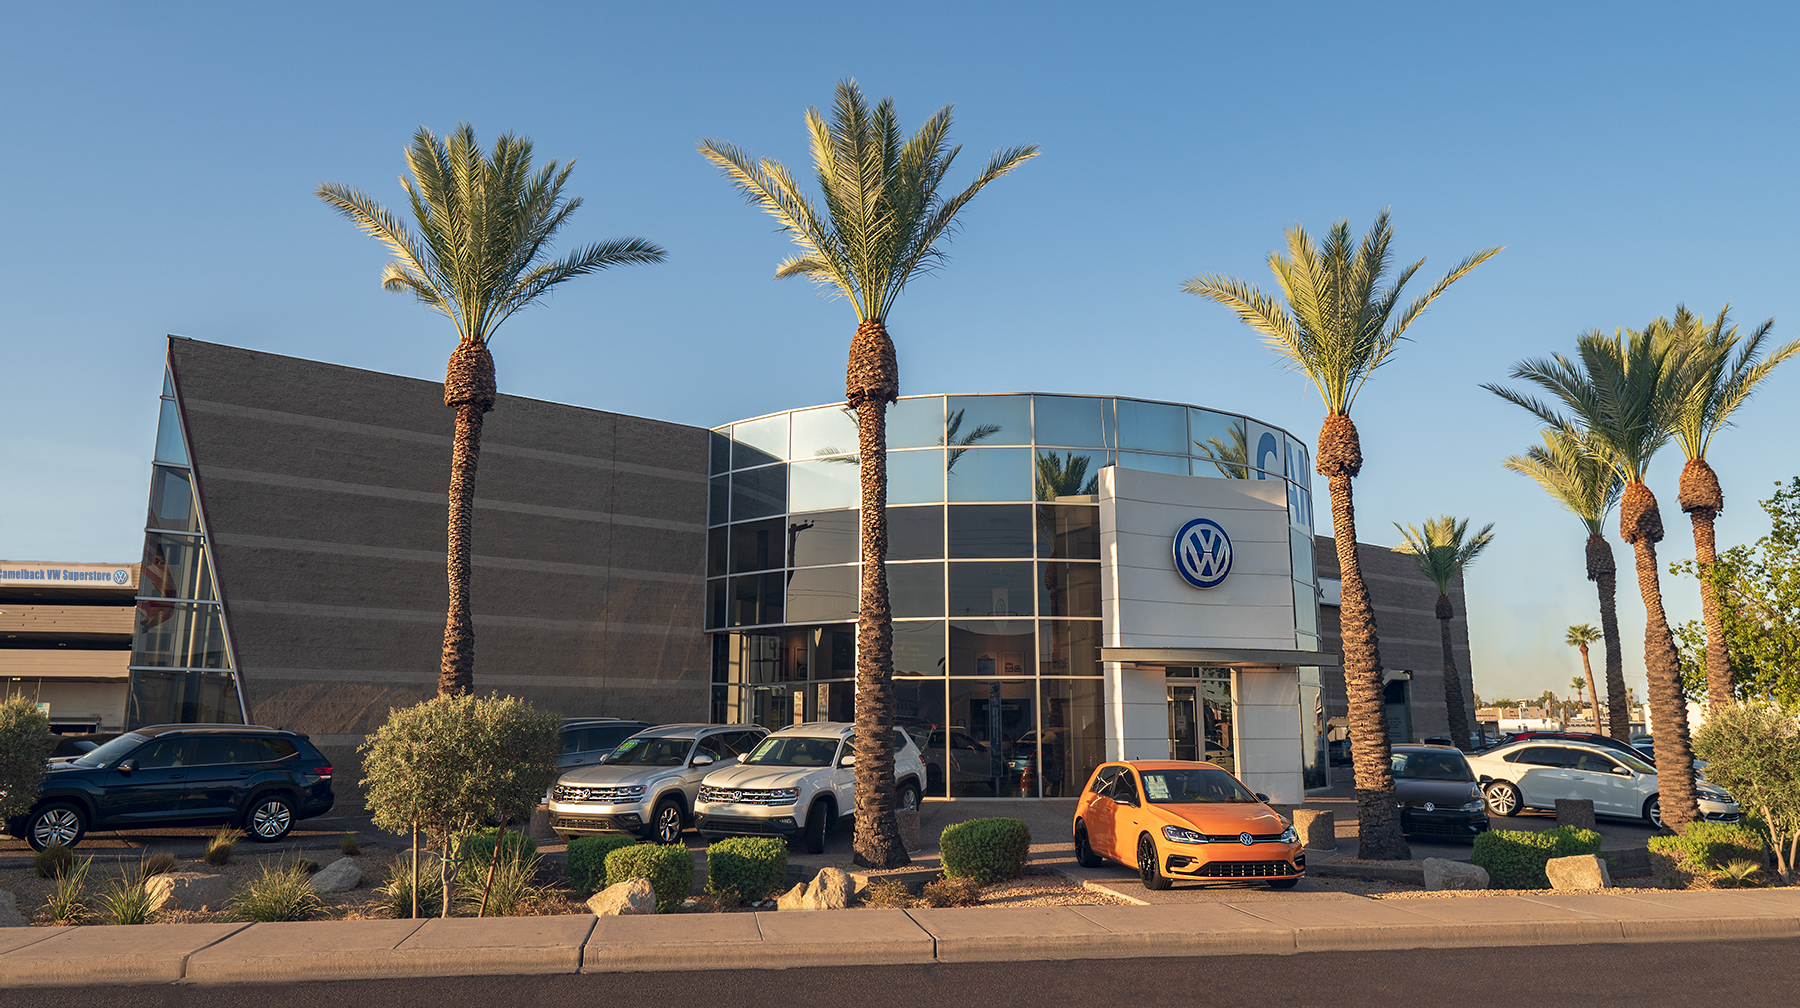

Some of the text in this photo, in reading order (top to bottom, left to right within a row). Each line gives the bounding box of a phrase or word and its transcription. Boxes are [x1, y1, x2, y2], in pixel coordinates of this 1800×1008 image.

[1179, 523, 1231, 583] VW
[47, 569, 61, 580] VW
[63, 569, 112, 581] Superstore
